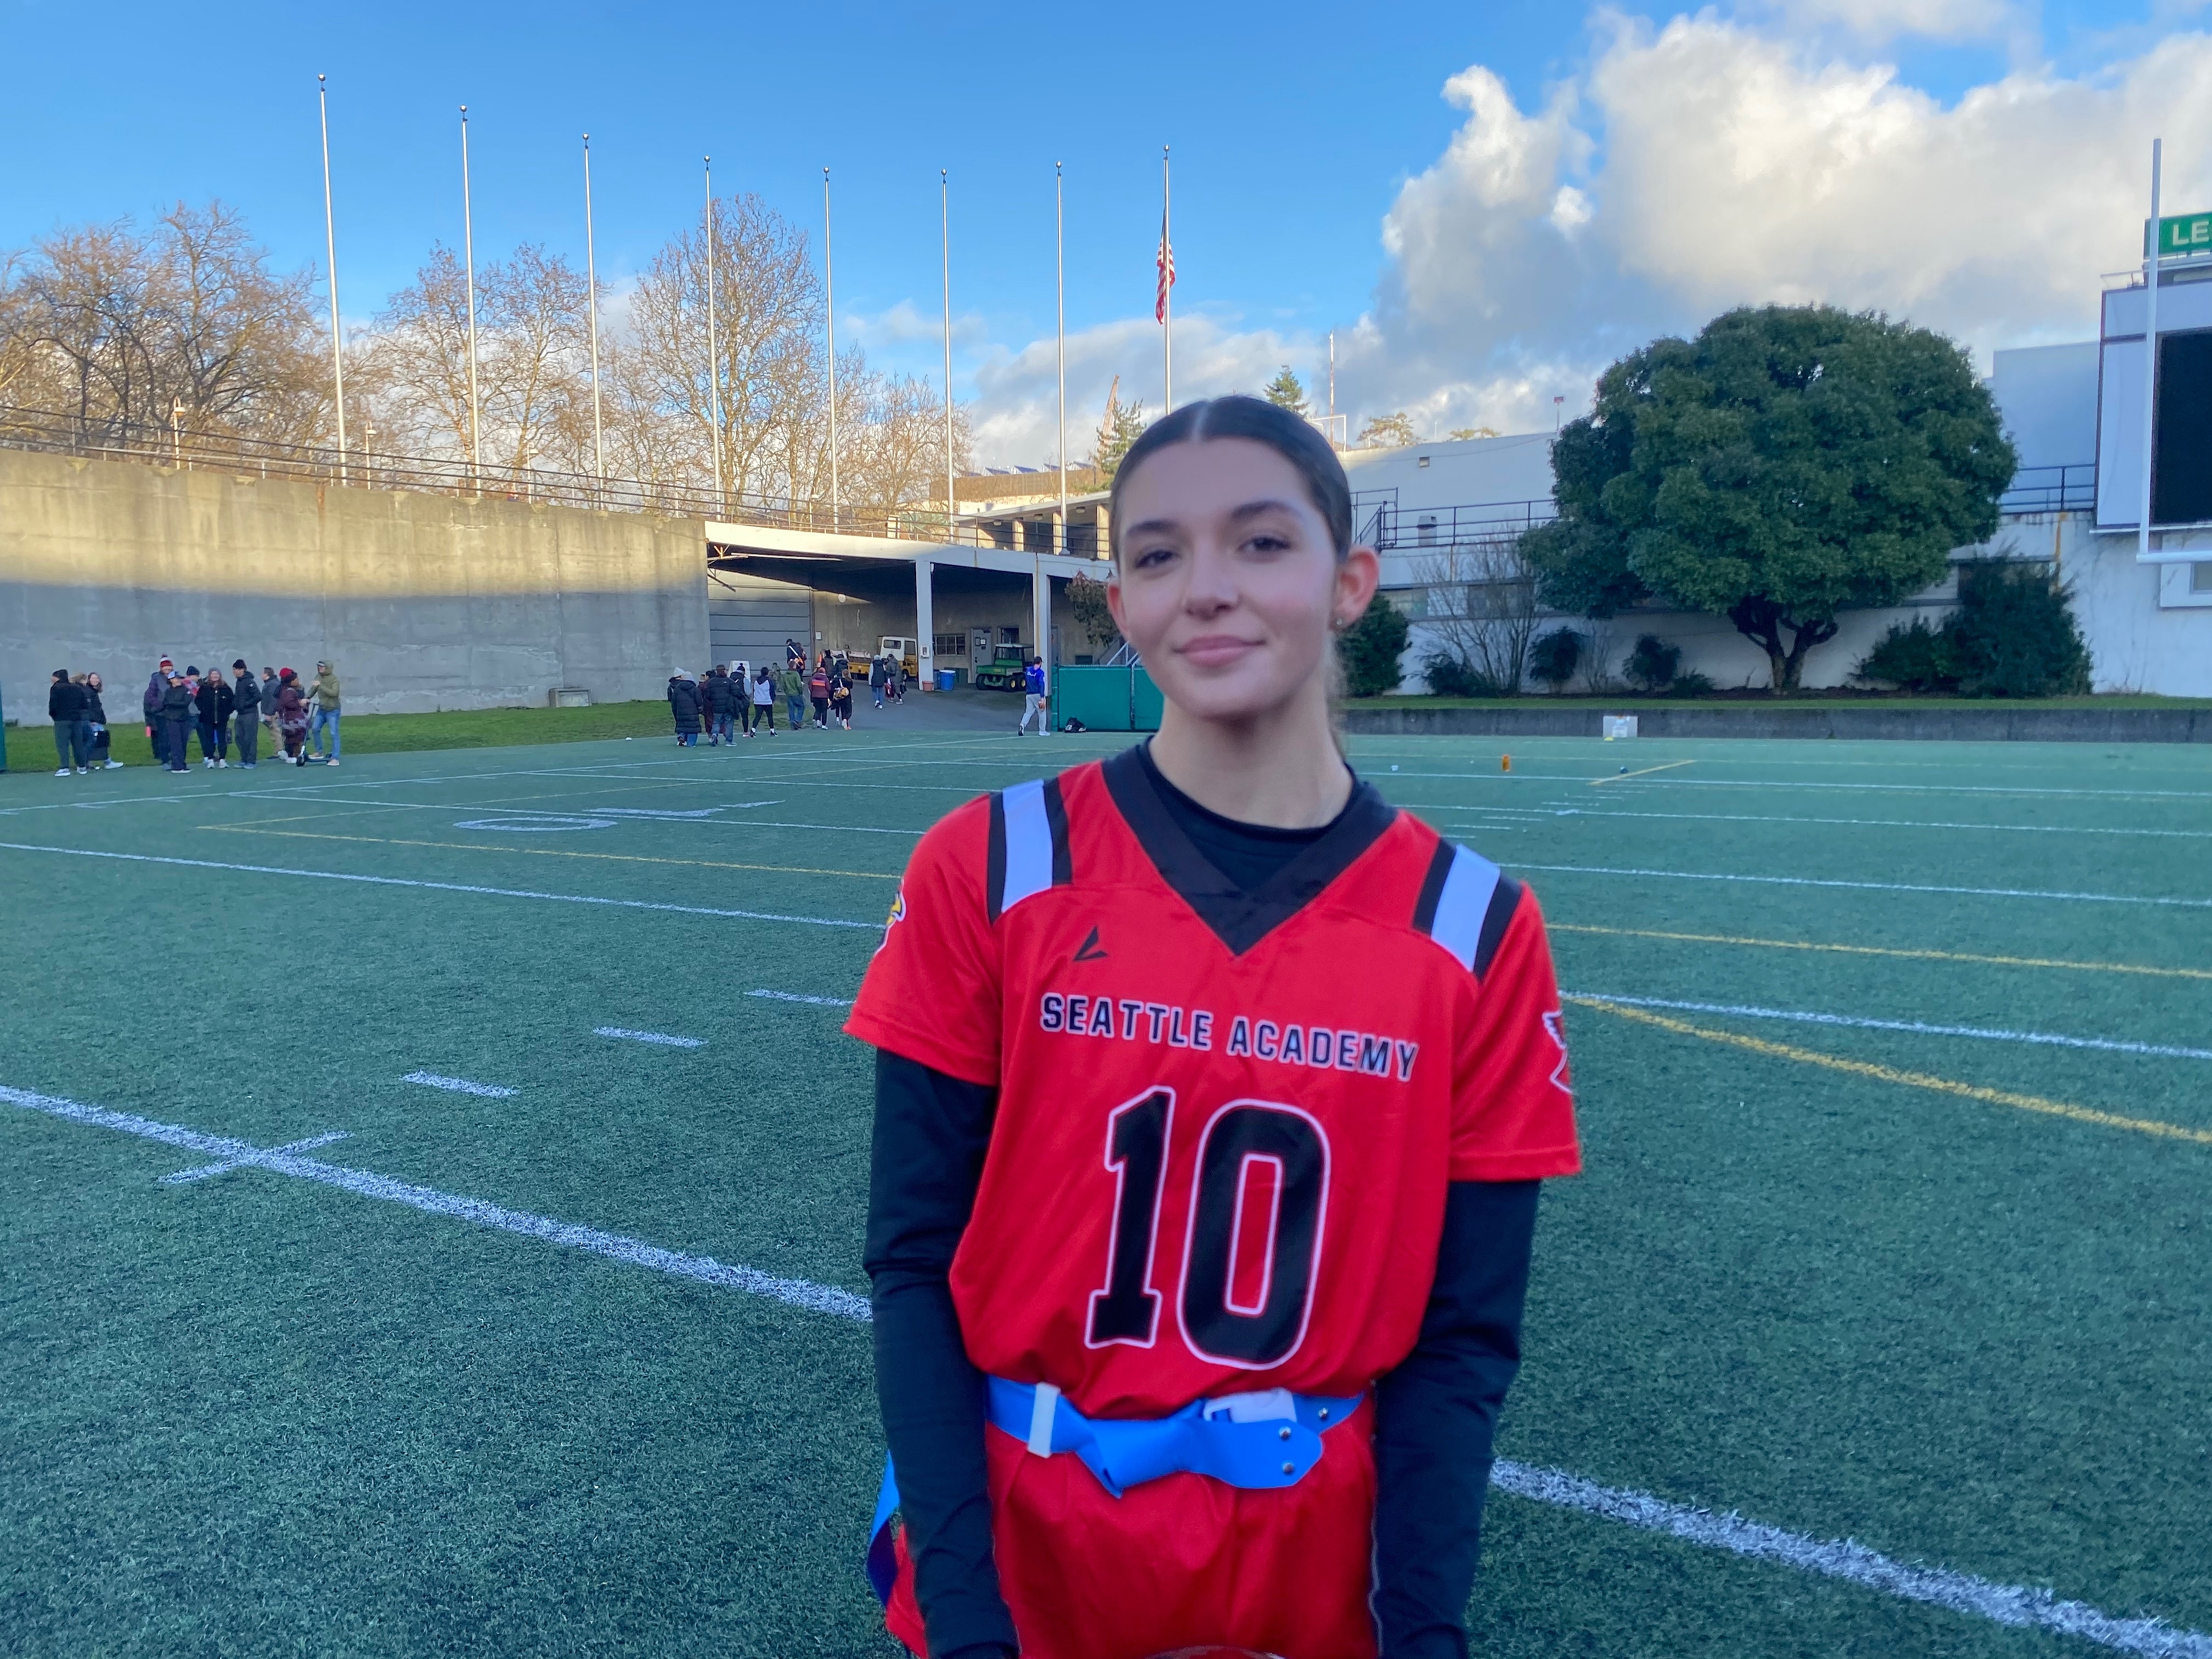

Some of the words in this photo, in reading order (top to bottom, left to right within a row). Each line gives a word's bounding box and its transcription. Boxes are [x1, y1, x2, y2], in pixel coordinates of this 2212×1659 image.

[1041, 993, 1213, 1050] SEATTLE
[1227, 1017, 1418, 1082] ACADEMY
[1085, 1085, 1331, 1370] 10
